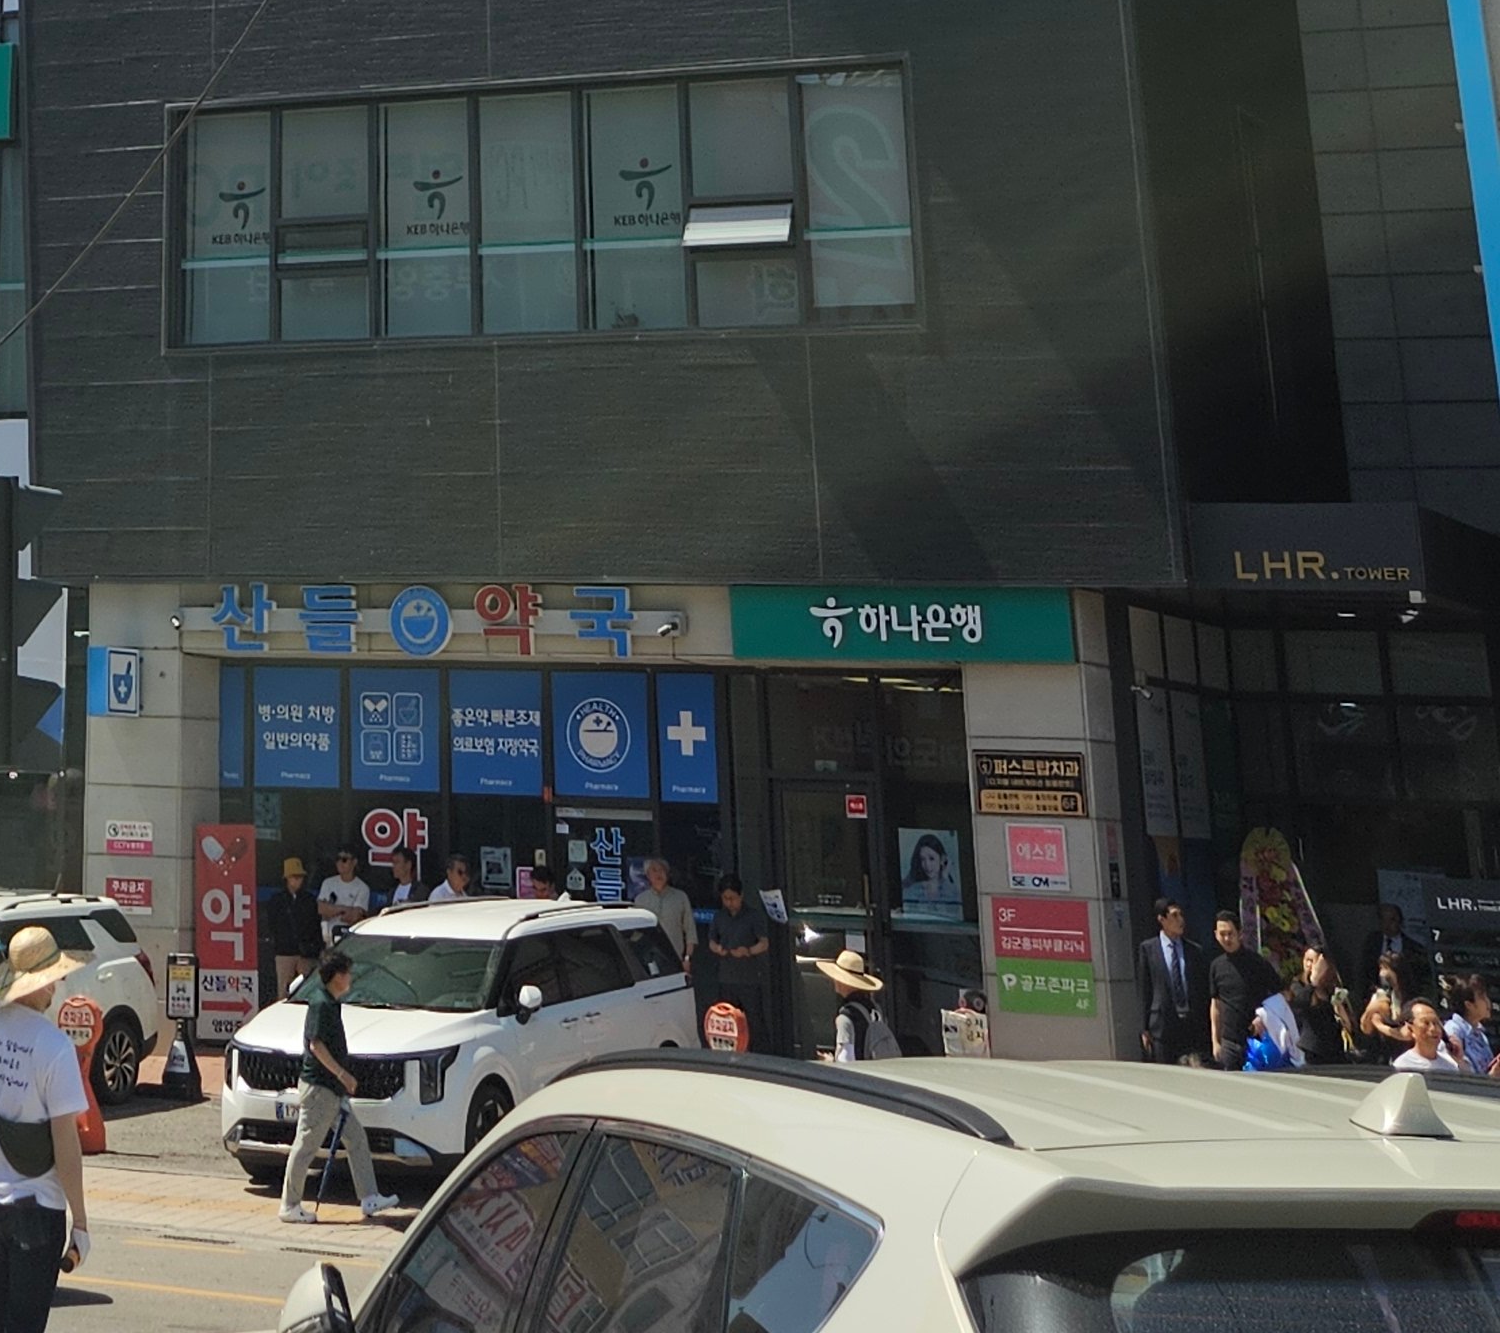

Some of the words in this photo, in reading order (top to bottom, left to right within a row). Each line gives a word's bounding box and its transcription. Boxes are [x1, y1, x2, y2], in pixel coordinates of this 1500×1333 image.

[614, 213, 637, 227] KEB
[1343, 565, 1411, 581] TOWER
[210, 582, 364, 654] 산들
[472, 582, 637, 660] 약국
[857, 602, 984, 644] 하나은행
[307, 704, 337, 725] 처방
[262, 730, 332, 753] 일반의약품
[453, 736, 495, 756] 의료보험
[496, 738, 541, 758] 지정약국
[993, 759, 1080, 778] 퍼스트탑치과
[360, 807, 430, 881] 약
[1015, 842, 1057, 862] 에스원
[589, 826, 626, 903] 산들
[201, 883, 252, 962] 약
[998, 907, 1017, 922] 3F
[201, 974, 254, 993] 산들약국
